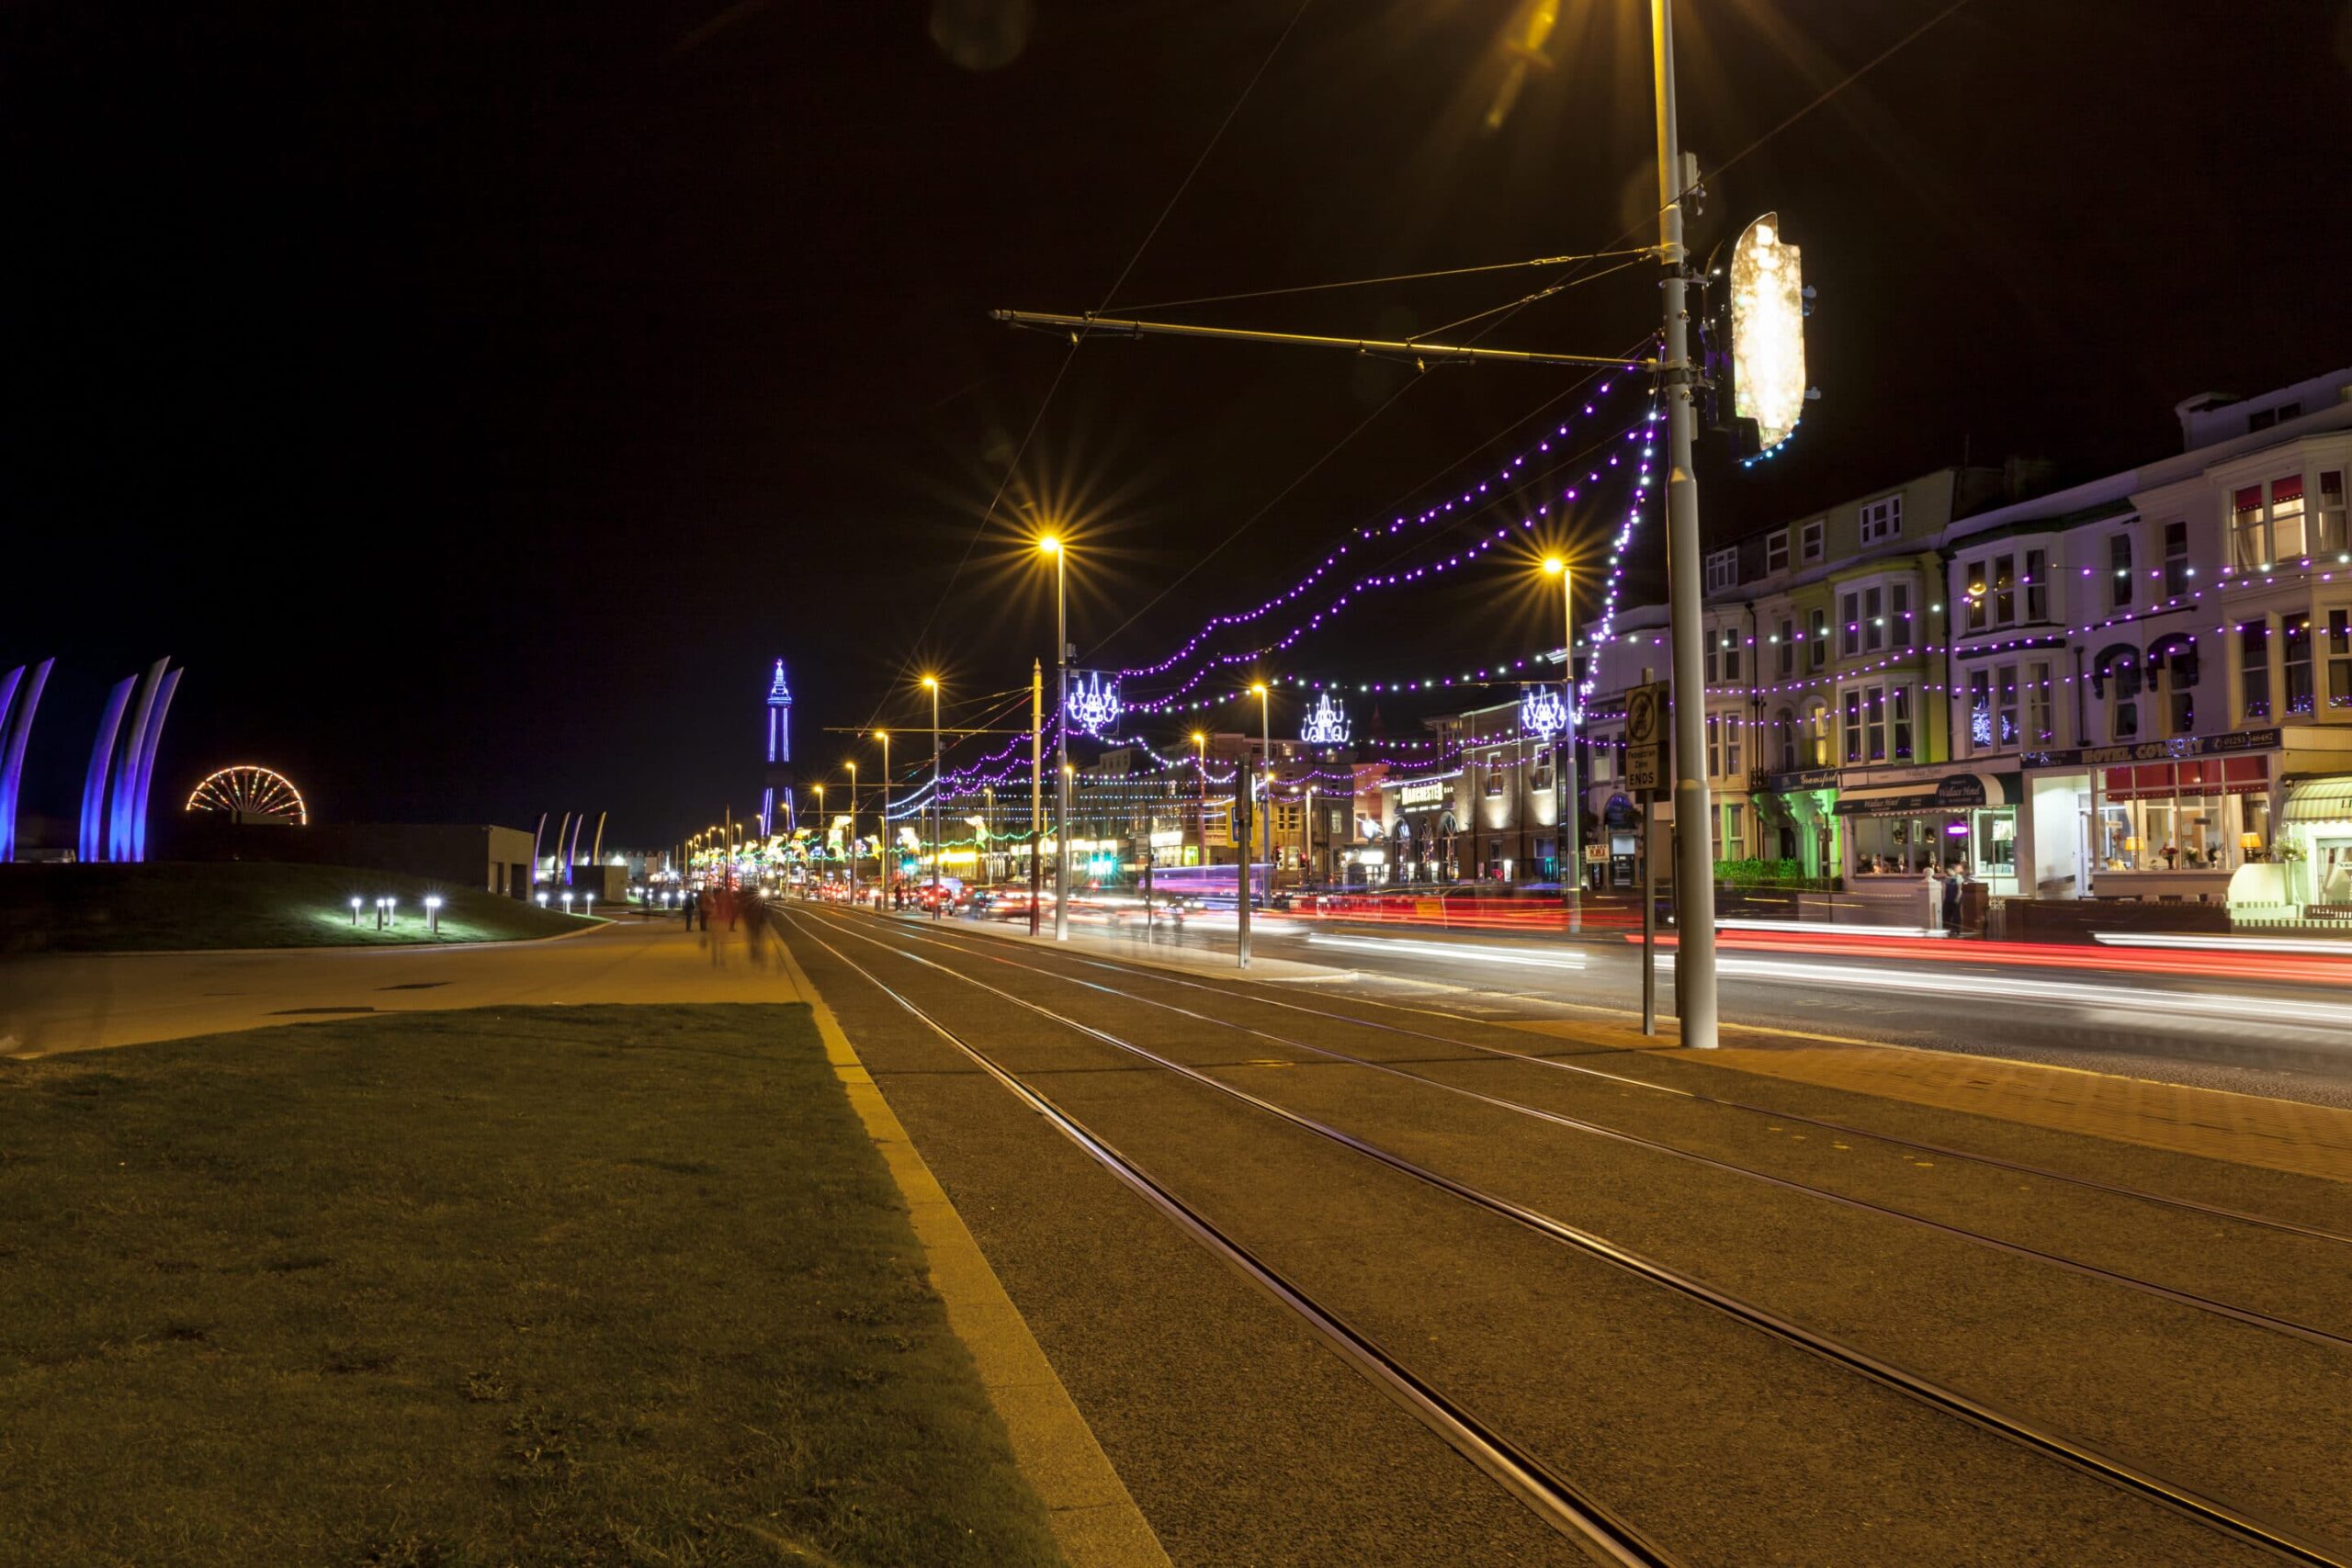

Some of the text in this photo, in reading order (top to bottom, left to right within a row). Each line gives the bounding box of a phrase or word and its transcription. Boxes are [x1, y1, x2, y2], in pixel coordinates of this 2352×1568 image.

[2082, 747, 2132, 764] HOTEL
[1630, 773, 1654, 785] ENDS
[1402, 782, 1443, 806] MANCHESTER
[1962, 784, 1982, 796] Hotel
